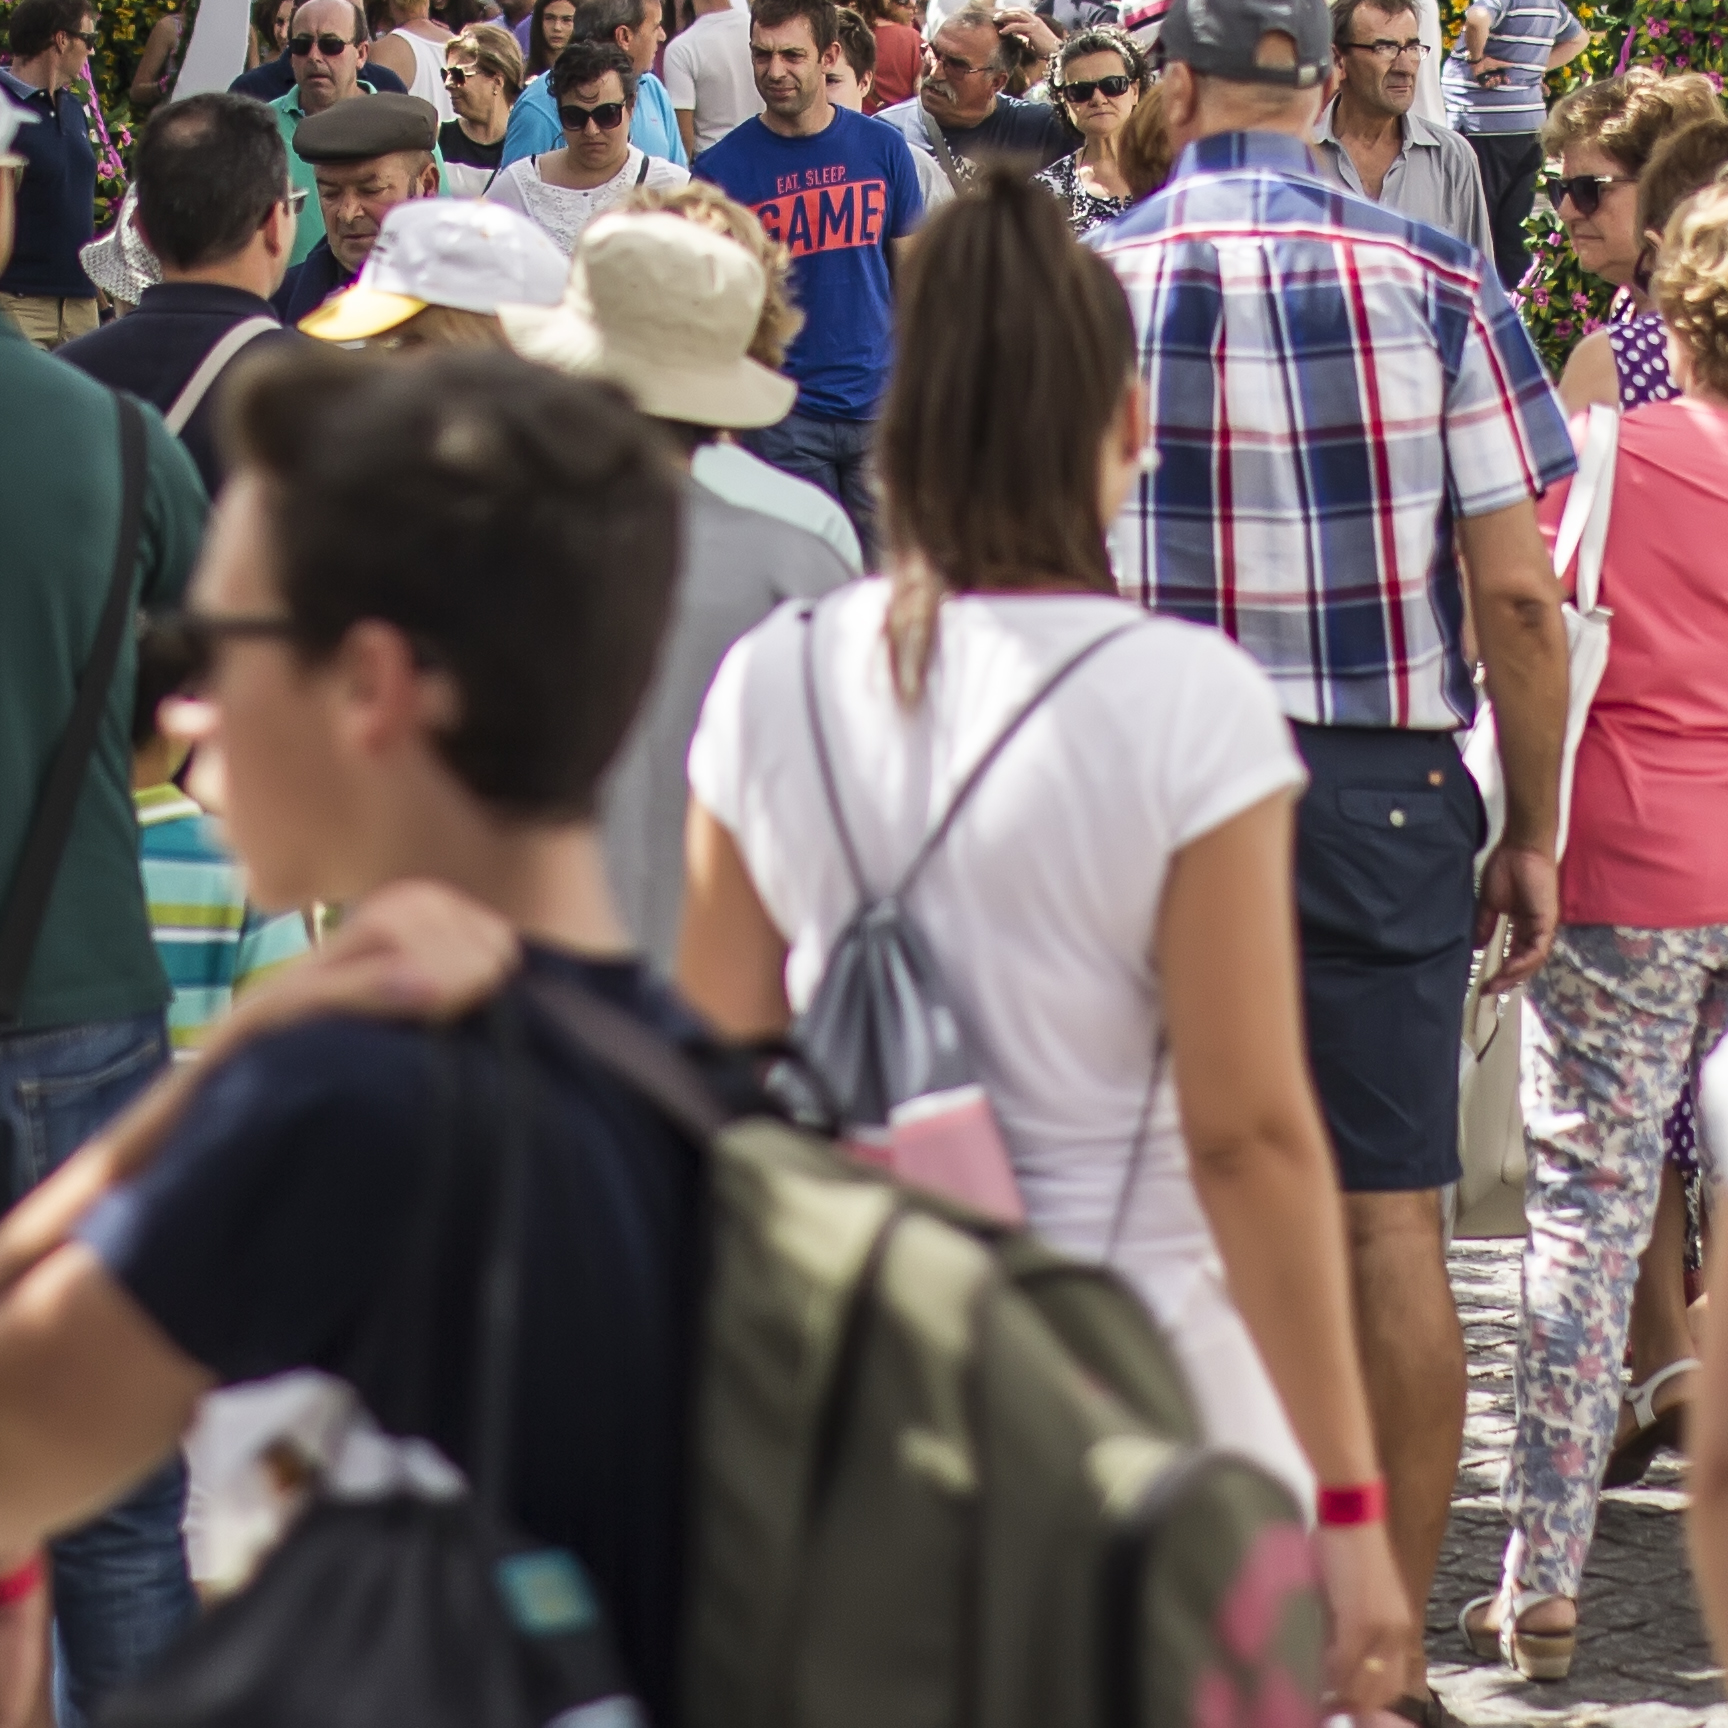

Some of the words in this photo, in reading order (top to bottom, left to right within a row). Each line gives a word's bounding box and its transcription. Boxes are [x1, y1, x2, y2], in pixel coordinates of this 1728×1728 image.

[777, 173, 801, 194] EAT.
[805, 165, 846, 187] SLEEP.
[758, 183, 881, 250] GAME
